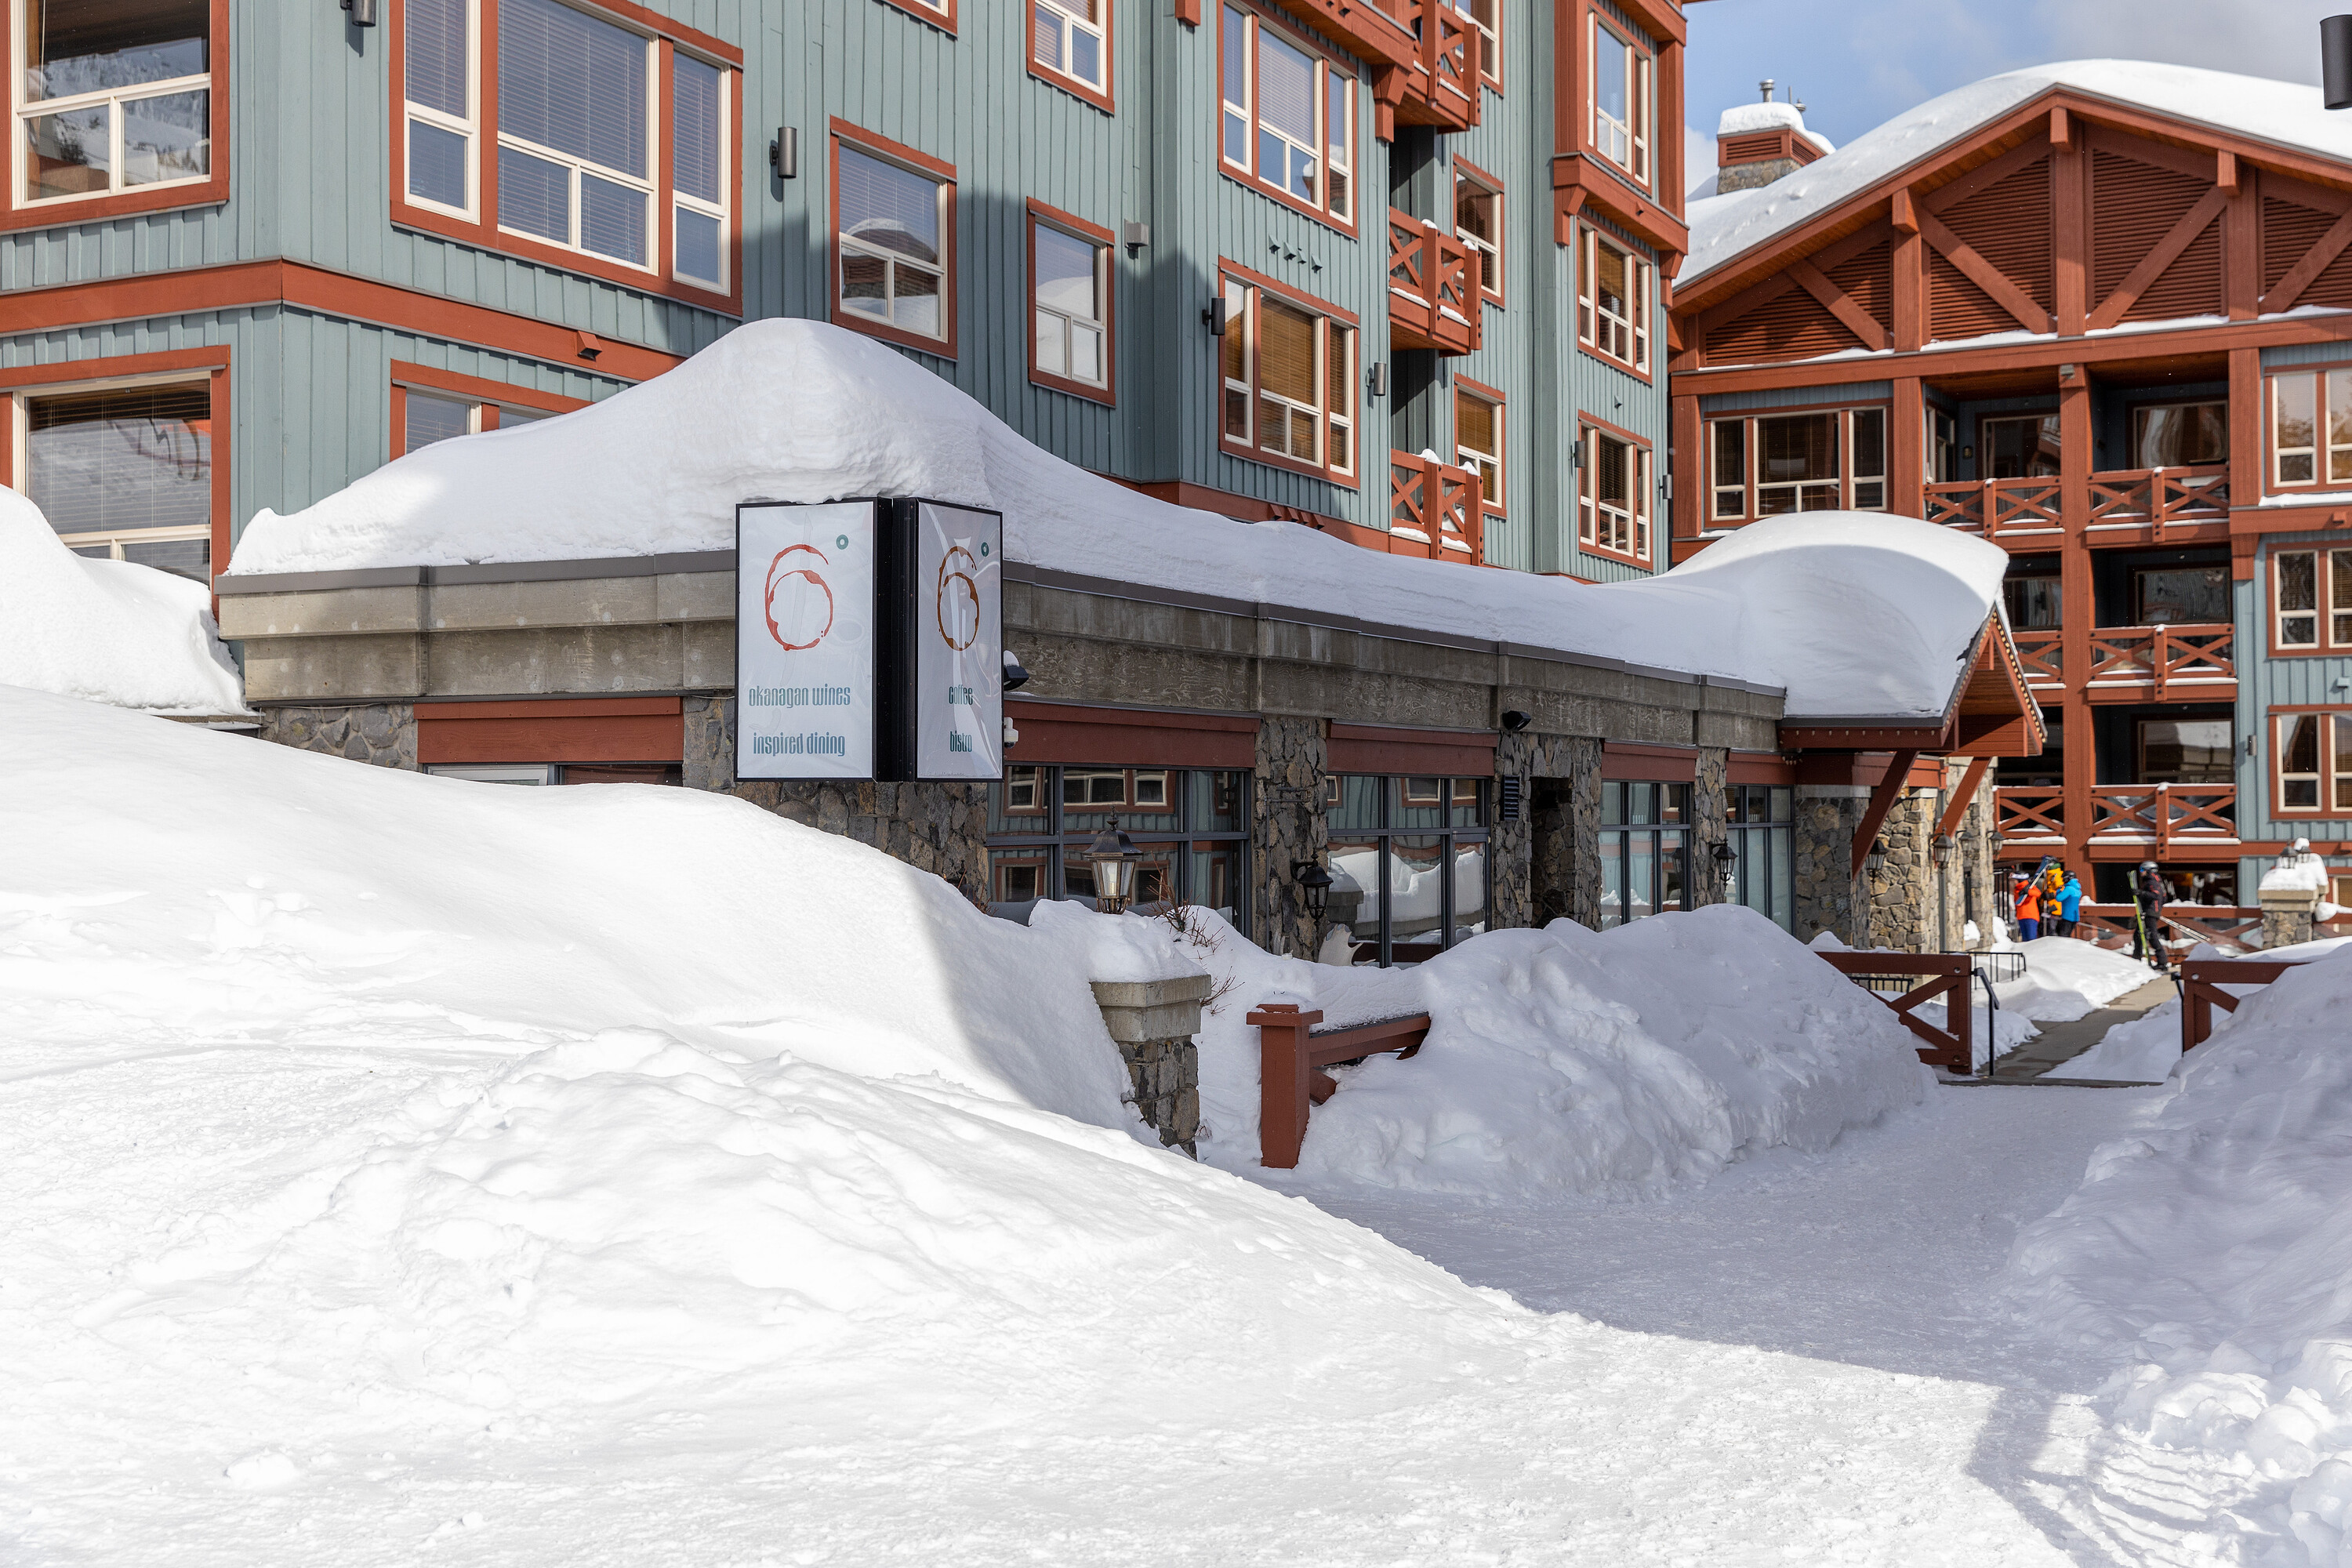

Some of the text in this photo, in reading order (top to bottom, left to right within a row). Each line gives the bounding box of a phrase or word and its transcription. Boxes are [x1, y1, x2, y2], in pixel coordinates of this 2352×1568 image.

[749, 684, 851, 709] okanagan wines
[949, 684, 974, 706] coffee
[753, 731, 846, 757] inspired dining
[949, 730, 972, 753] bistro
